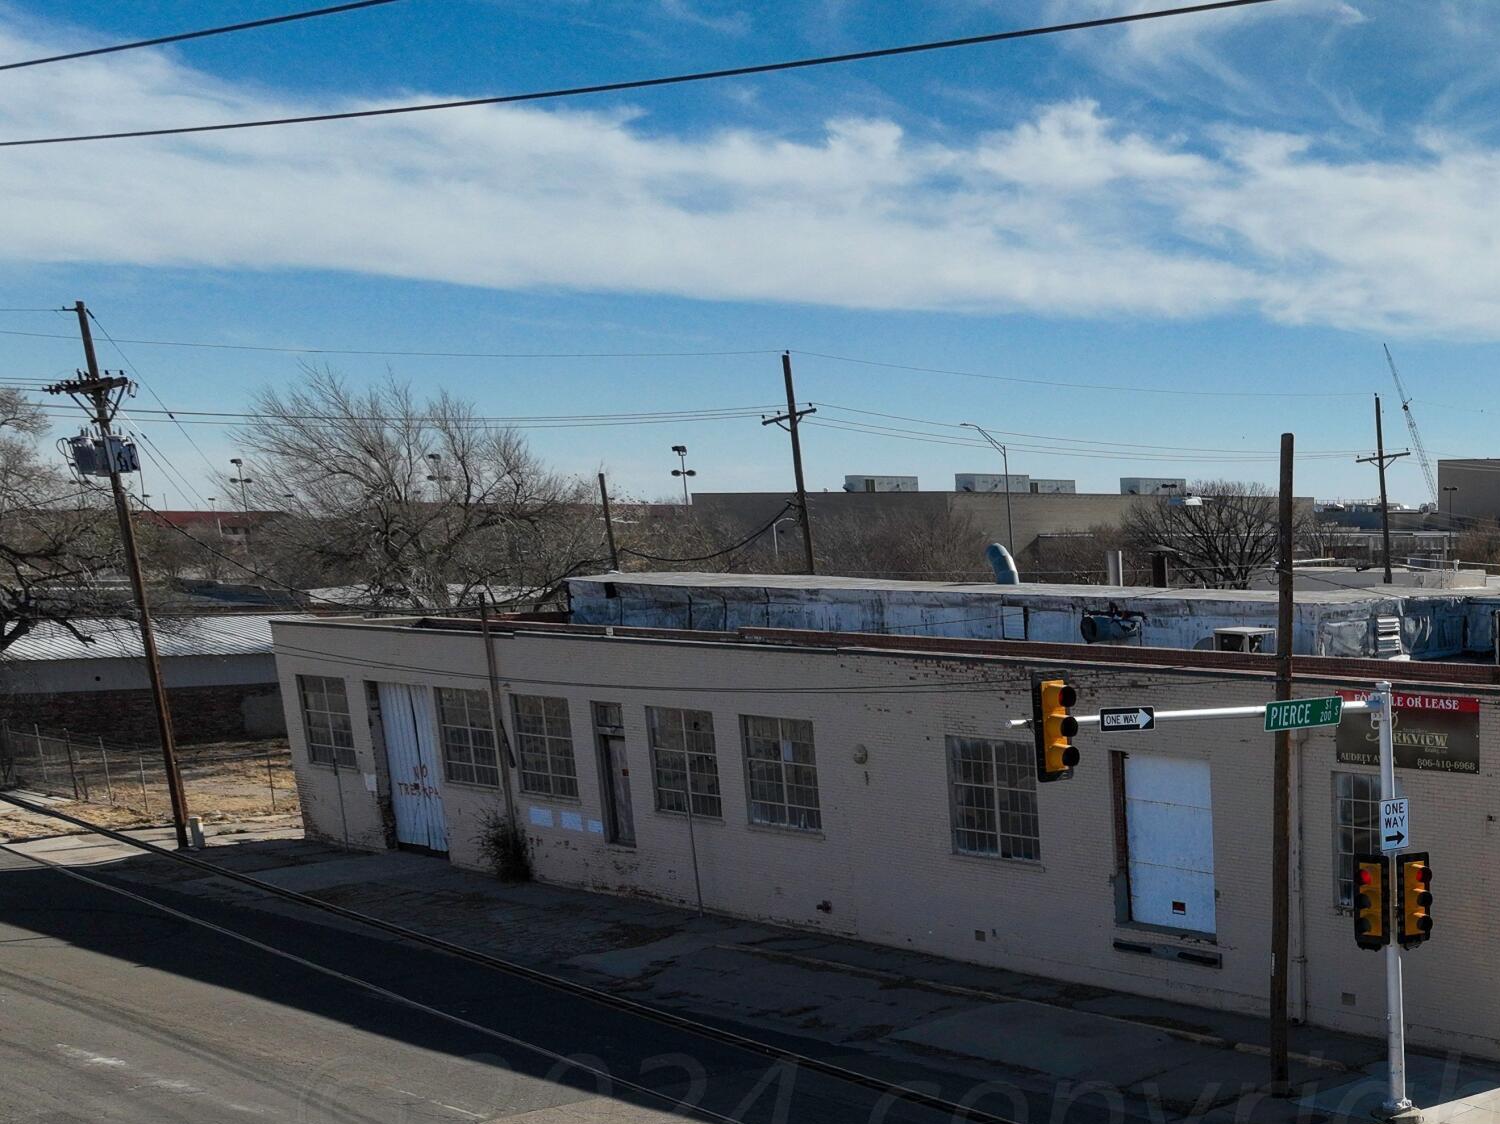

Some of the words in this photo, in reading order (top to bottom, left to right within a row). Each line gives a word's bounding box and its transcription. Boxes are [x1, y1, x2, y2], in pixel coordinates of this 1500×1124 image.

[1325, 699, 1333, 710] ST
[1406, 697, 1423, 708] OR
[1425, 698, 1460, 711] LEASE
[1105, 715, 1121, 724] ONE
[1123, 714, 1138, 724] WAY
[1270, 704, 1311, 727] PIERCE
[1320, 711, 1332, 722] 200
[1365, 711, 1449, 747] PRKVIEW
[1385, 802, 1404, 815] ONE
[1384, 816, 1405, 829] WAY
